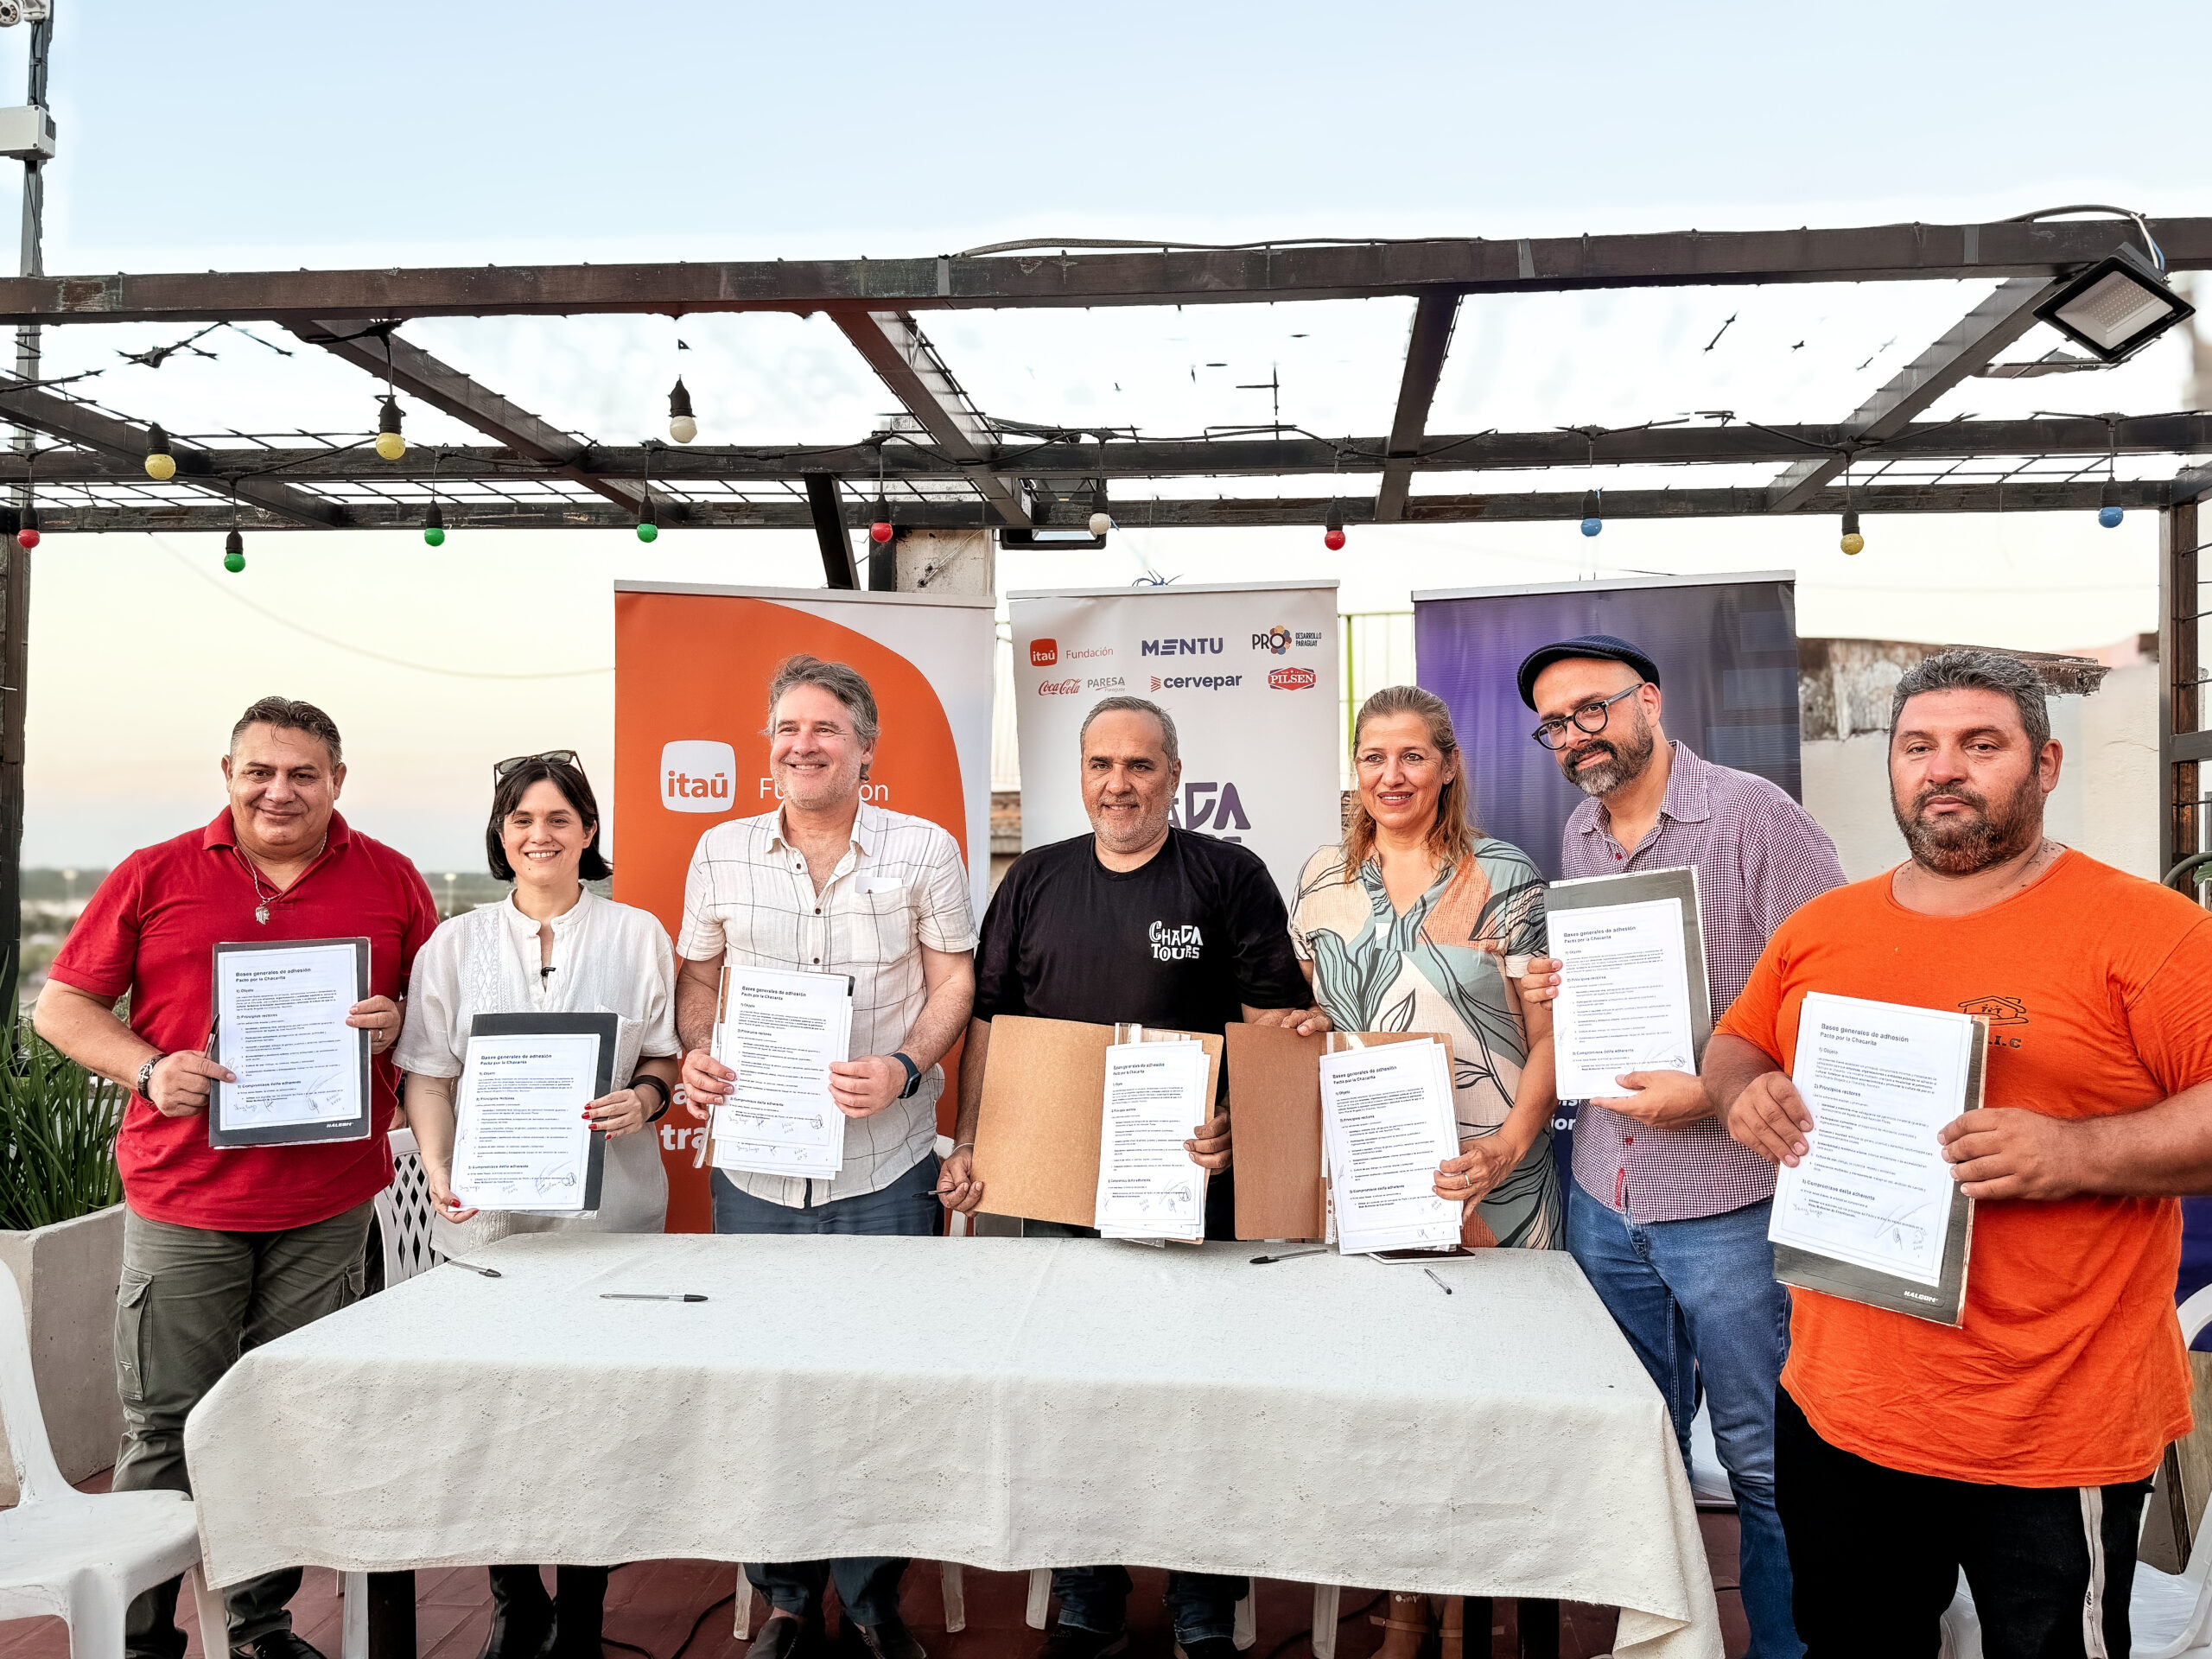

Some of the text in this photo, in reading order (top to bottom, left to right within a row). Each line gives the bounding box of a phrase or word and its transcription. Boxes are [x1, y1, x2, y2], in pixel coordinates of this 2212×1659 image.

[1141, 638, 1224, 656] MENTU
[1252, 632, 1286, 650] PRO
[1033, 646, 1114, 662] itaú Fundación
[1087, 676, 1126, 689] PARESA
[1163, 675, 1243, 690] cervepar
[1270, 674, 1314, 683] PILSEN
[668, 770, 728, 798] itaú
